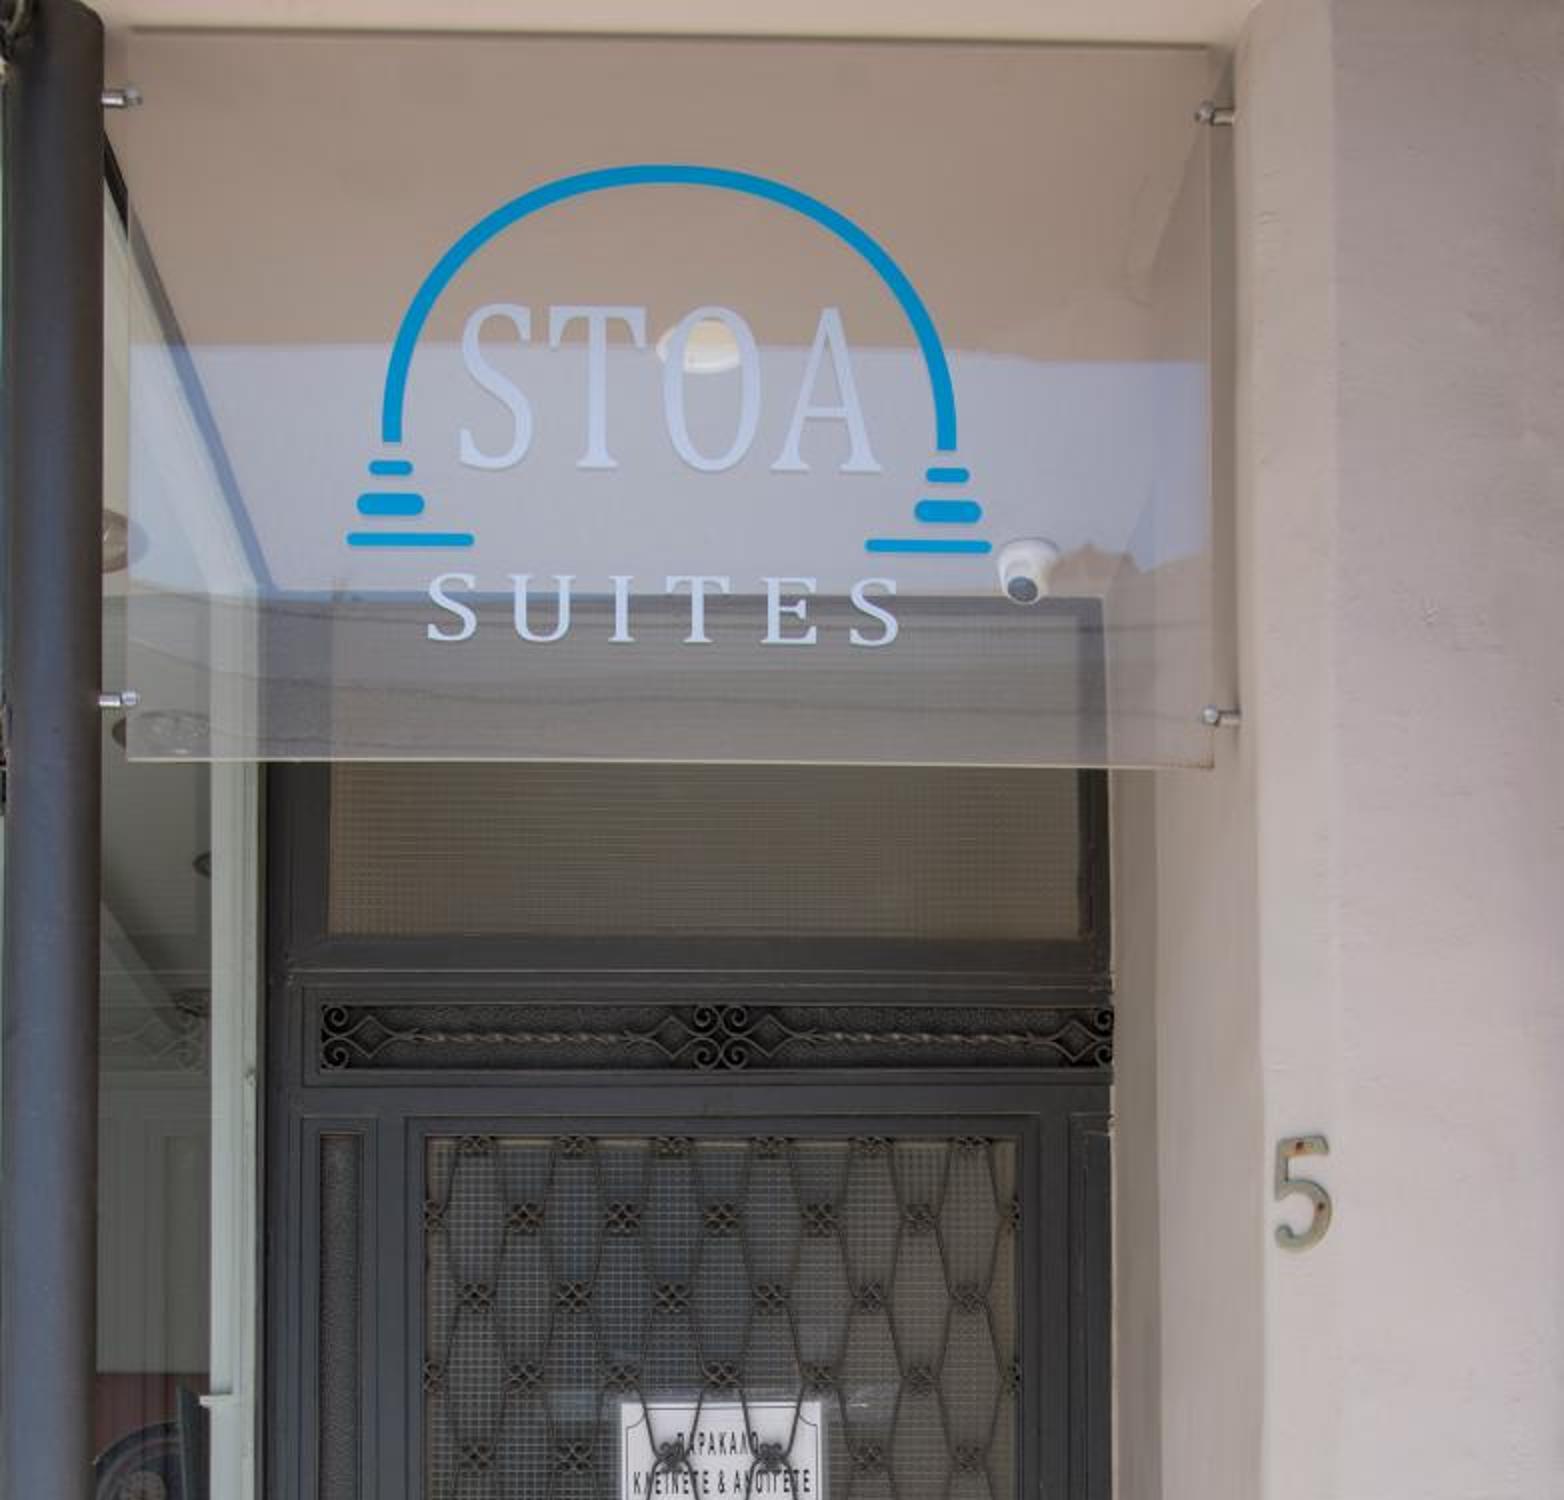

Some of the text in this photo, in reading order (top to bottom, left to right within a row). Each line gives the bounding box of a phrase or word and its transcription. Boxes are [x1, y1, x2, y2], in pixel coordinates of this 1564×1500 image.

[457, 303, 883, 475] STOA
[426, 572, 901, 647] SUITES
[1274, 1134, 1334, 1252] 5
[717, 1470, 726, 1494] &
